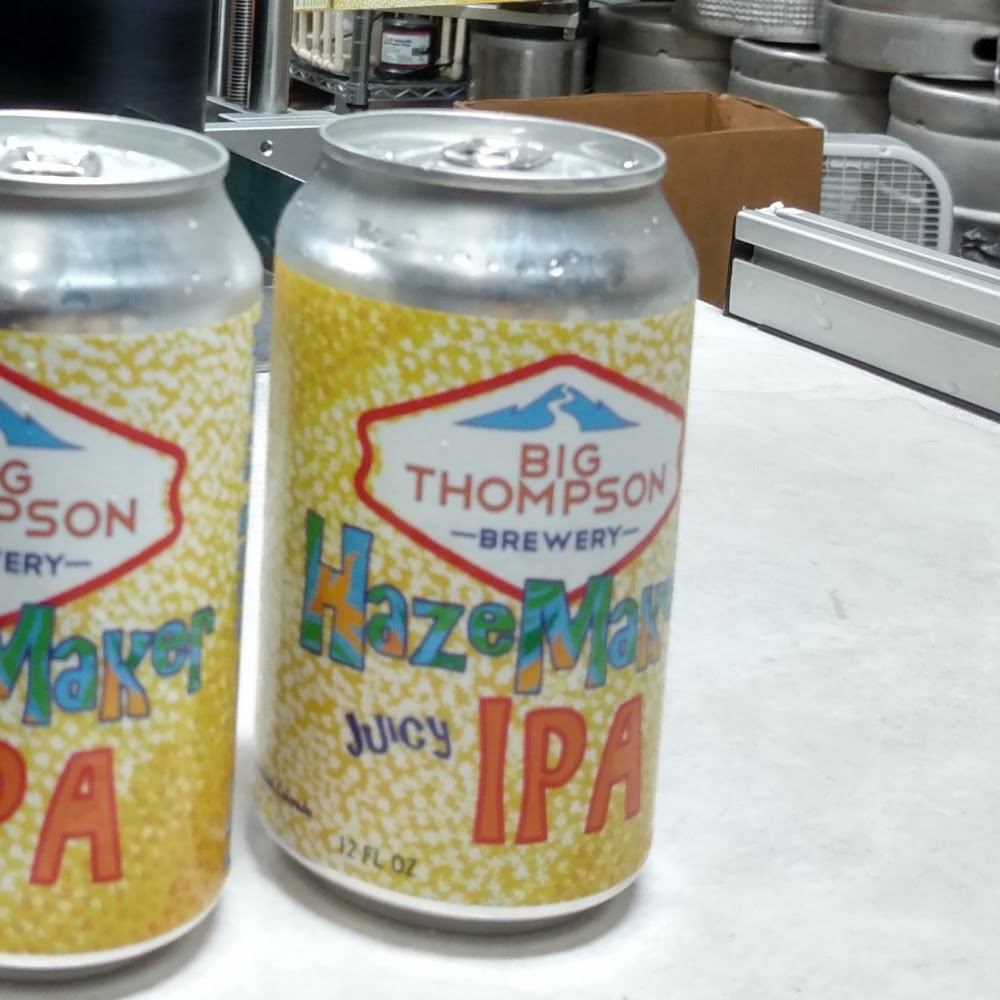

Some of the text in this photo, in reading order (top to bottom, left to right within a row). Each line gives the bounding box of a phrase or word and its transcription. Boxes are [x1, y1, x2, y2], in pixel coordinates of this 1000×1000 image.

[520, 443, 600, 478] BIG
[405, 463, 666, 516] THOMPSON
[479, 525, 622, 552] BREWERY
[300, 509, 674, 695] HazeMak
[471, 692, 644, 846] IPA
[339, 835, 417, 878] 12 FL OZ
